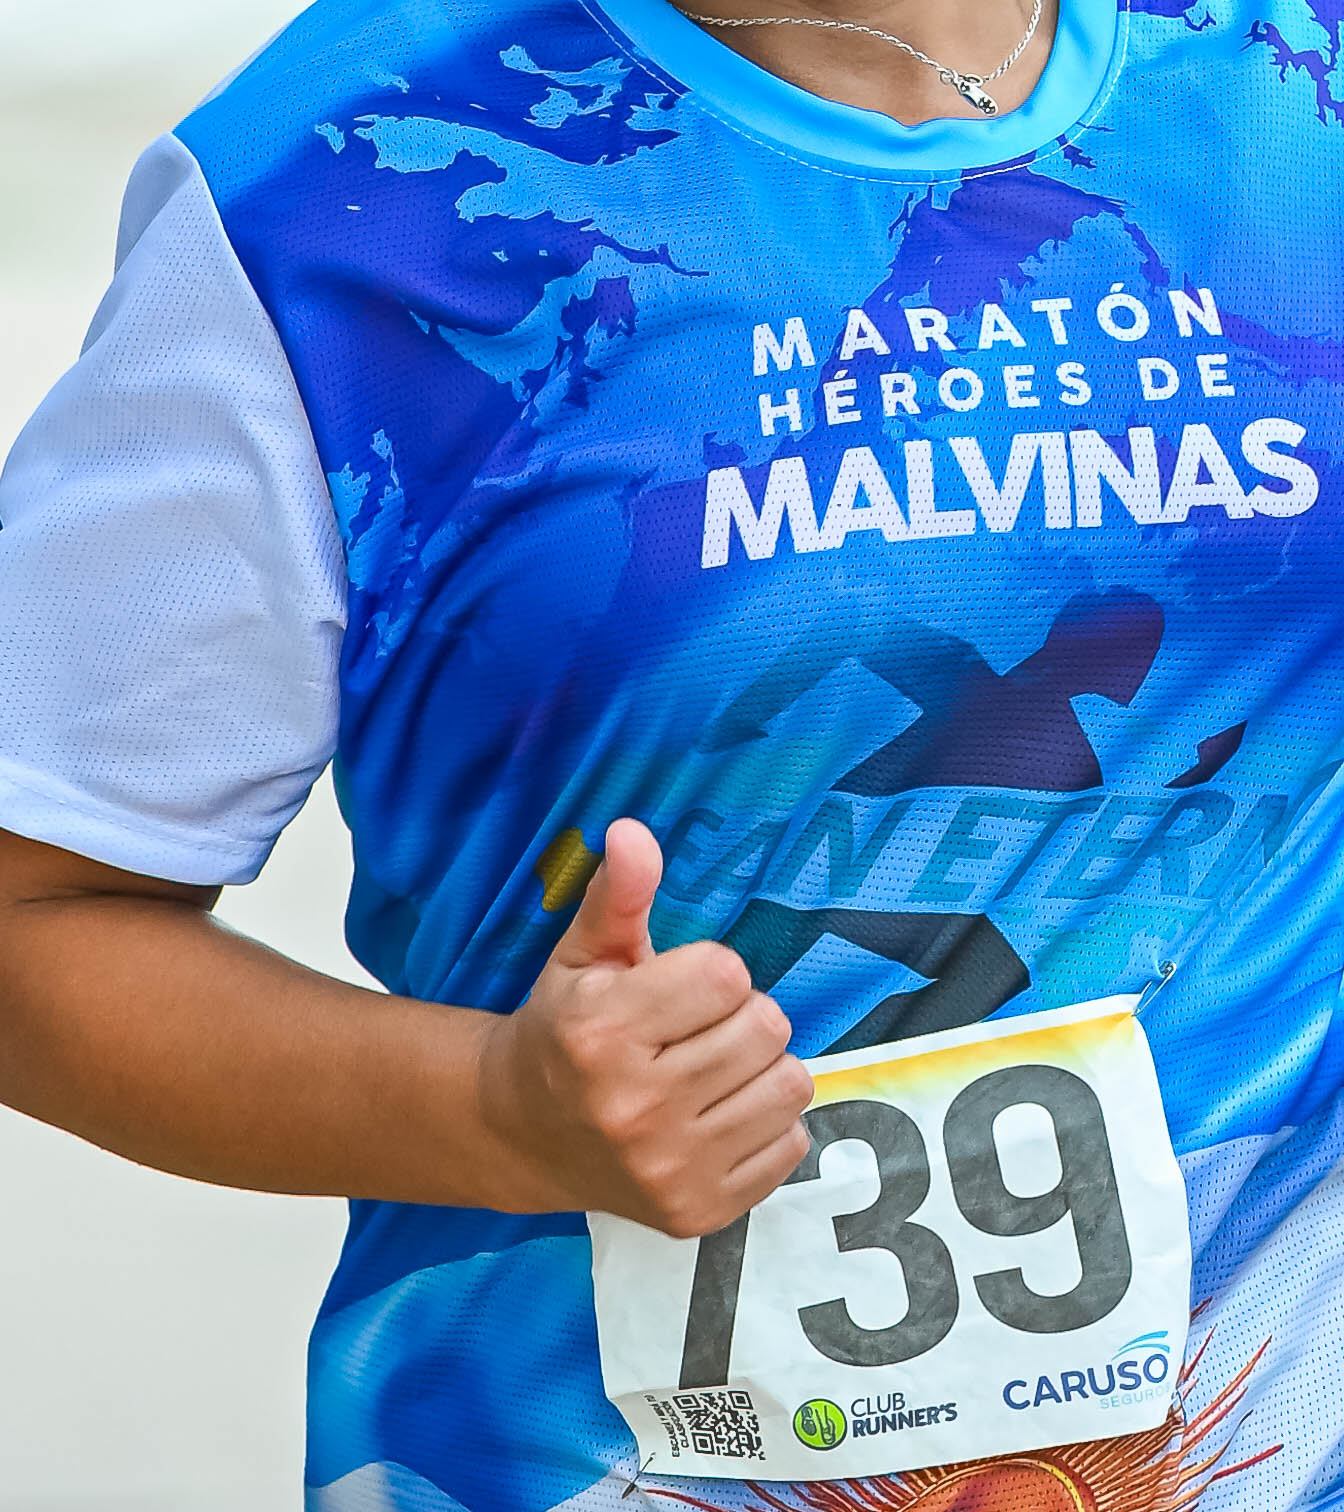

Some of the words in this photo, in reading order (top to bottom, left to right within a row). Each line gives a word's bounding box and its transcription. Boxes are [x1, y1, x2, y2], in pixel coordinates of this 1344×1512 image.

[751, 282, 1224, 377] MARATÓN
[757, 361, 1092, 437] HÉROES
[1141, 353, 1235, 400] DE
[700, 417, 1319, 569] MALVINAS
[851, 1392, 905, 1417] CLUB
[1003, 1354, 1168, 1410] CARUSO
[852, 1403, 958, 1438] RUNNER'S
